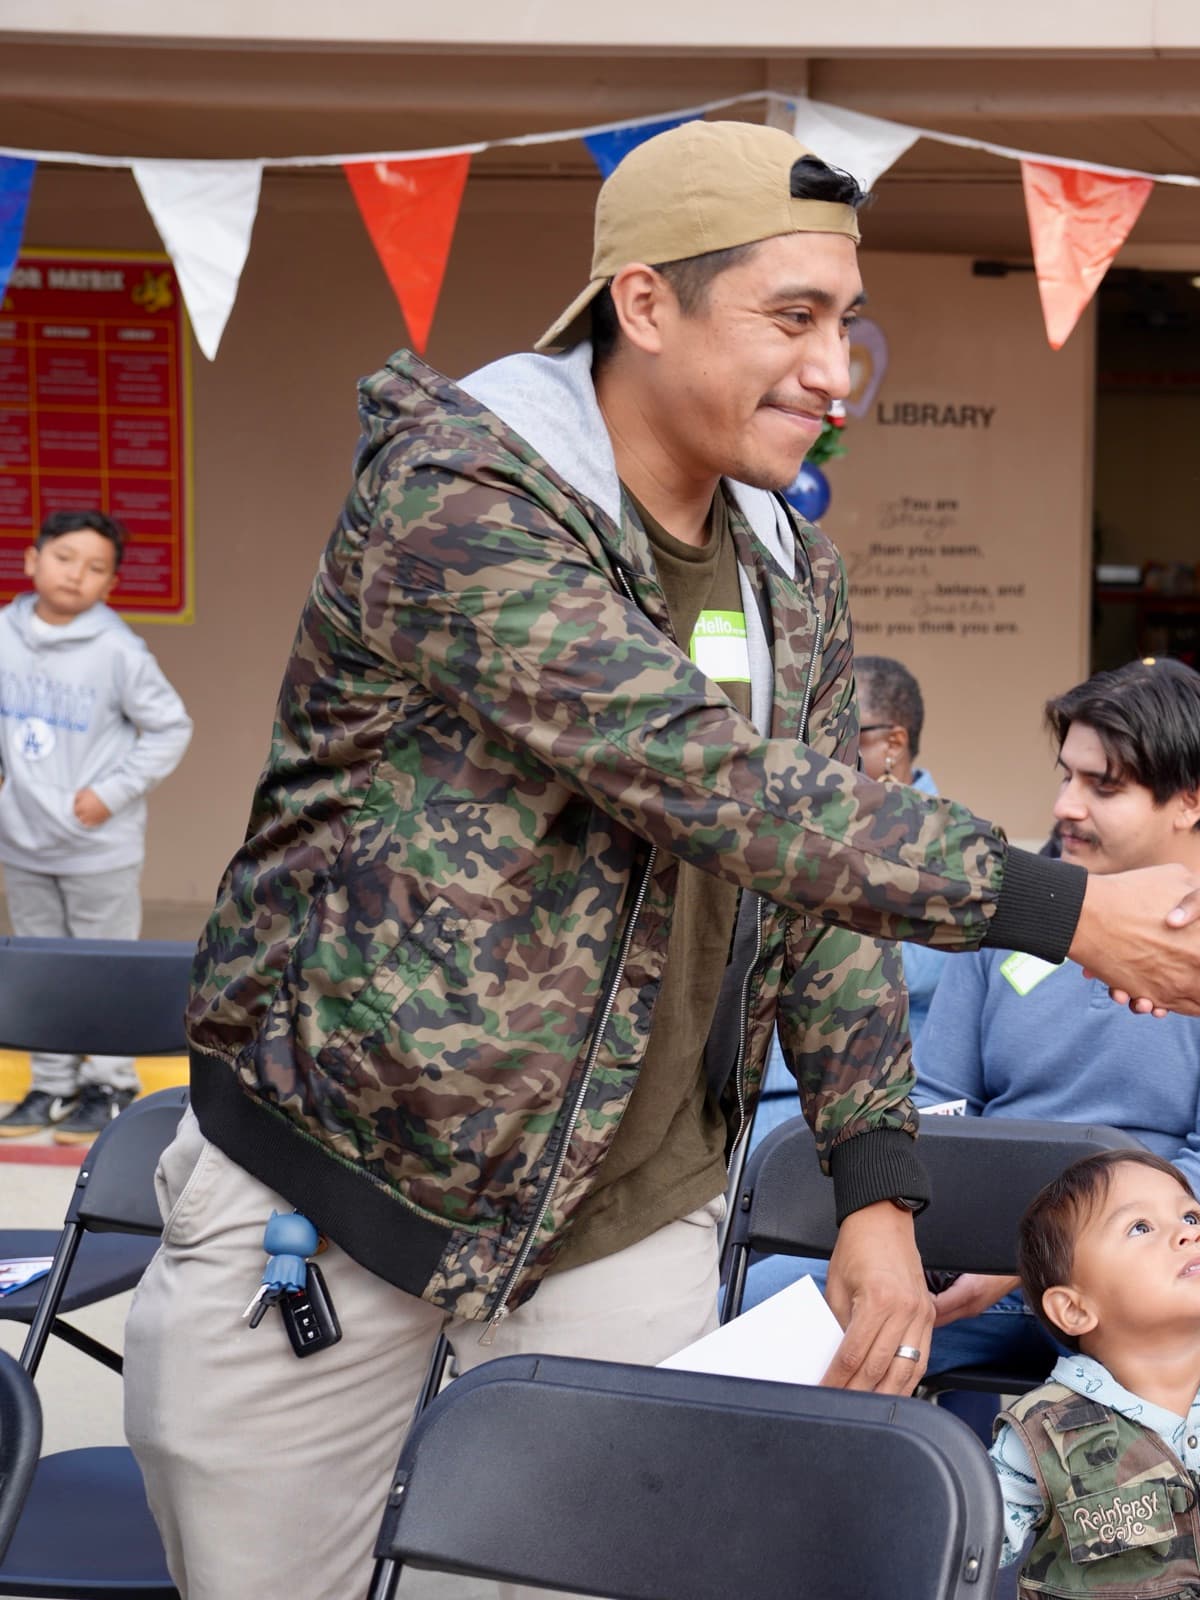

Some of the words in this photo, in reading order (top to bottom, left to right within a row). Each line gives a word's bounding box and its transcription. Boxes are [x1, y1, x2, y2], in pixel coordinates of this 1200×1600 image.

[876, 403, 996, 428] LIBRARY
[907, 546, 936, 559] you
[885, 586, 912, 600] you
[887, 623, 914, 637] you
[960, 623, 989, 637] you
